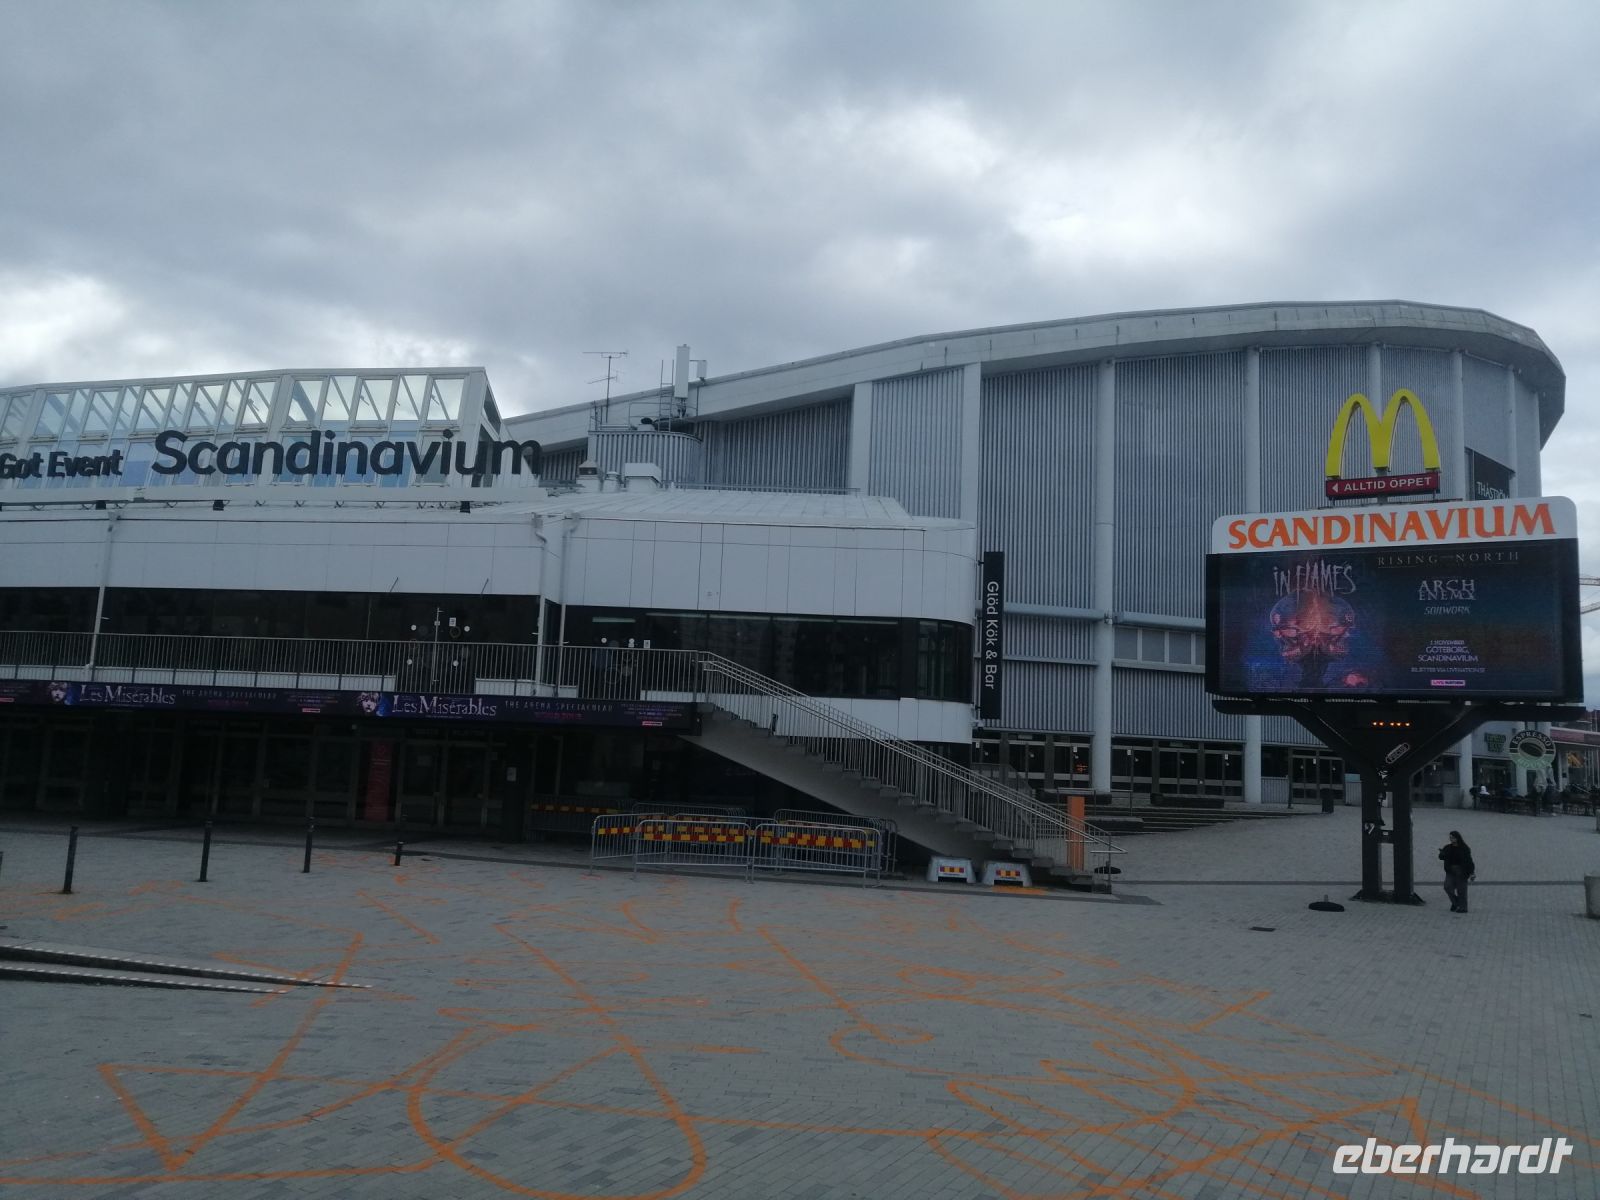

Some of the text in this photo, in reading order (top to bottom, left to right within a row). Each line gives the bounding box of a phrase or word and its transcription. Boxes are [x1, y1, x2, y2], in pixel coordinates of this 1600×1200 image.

[0, 449, 123, 479] Got Event
[151, 429, 543, 477] Scandinavium
[1343, 475, 1432, 493] ALLTID ÖPPET
[1228, 503, 1557, 550] SCANDINAVIUM
[1377, 551, 1519, 567] RISING NORTH
[1418, 579, 1476, 592] ARCH
[985, 581, 999, 690] Glöd Kök & Bar
[1417, 654, 1479, 662] SCANDINAVIUM
[80, 684, 177, 706] Les Misérables
[391, 694, 418, 713] Les
[418, 695, 497, 717] Misérables
